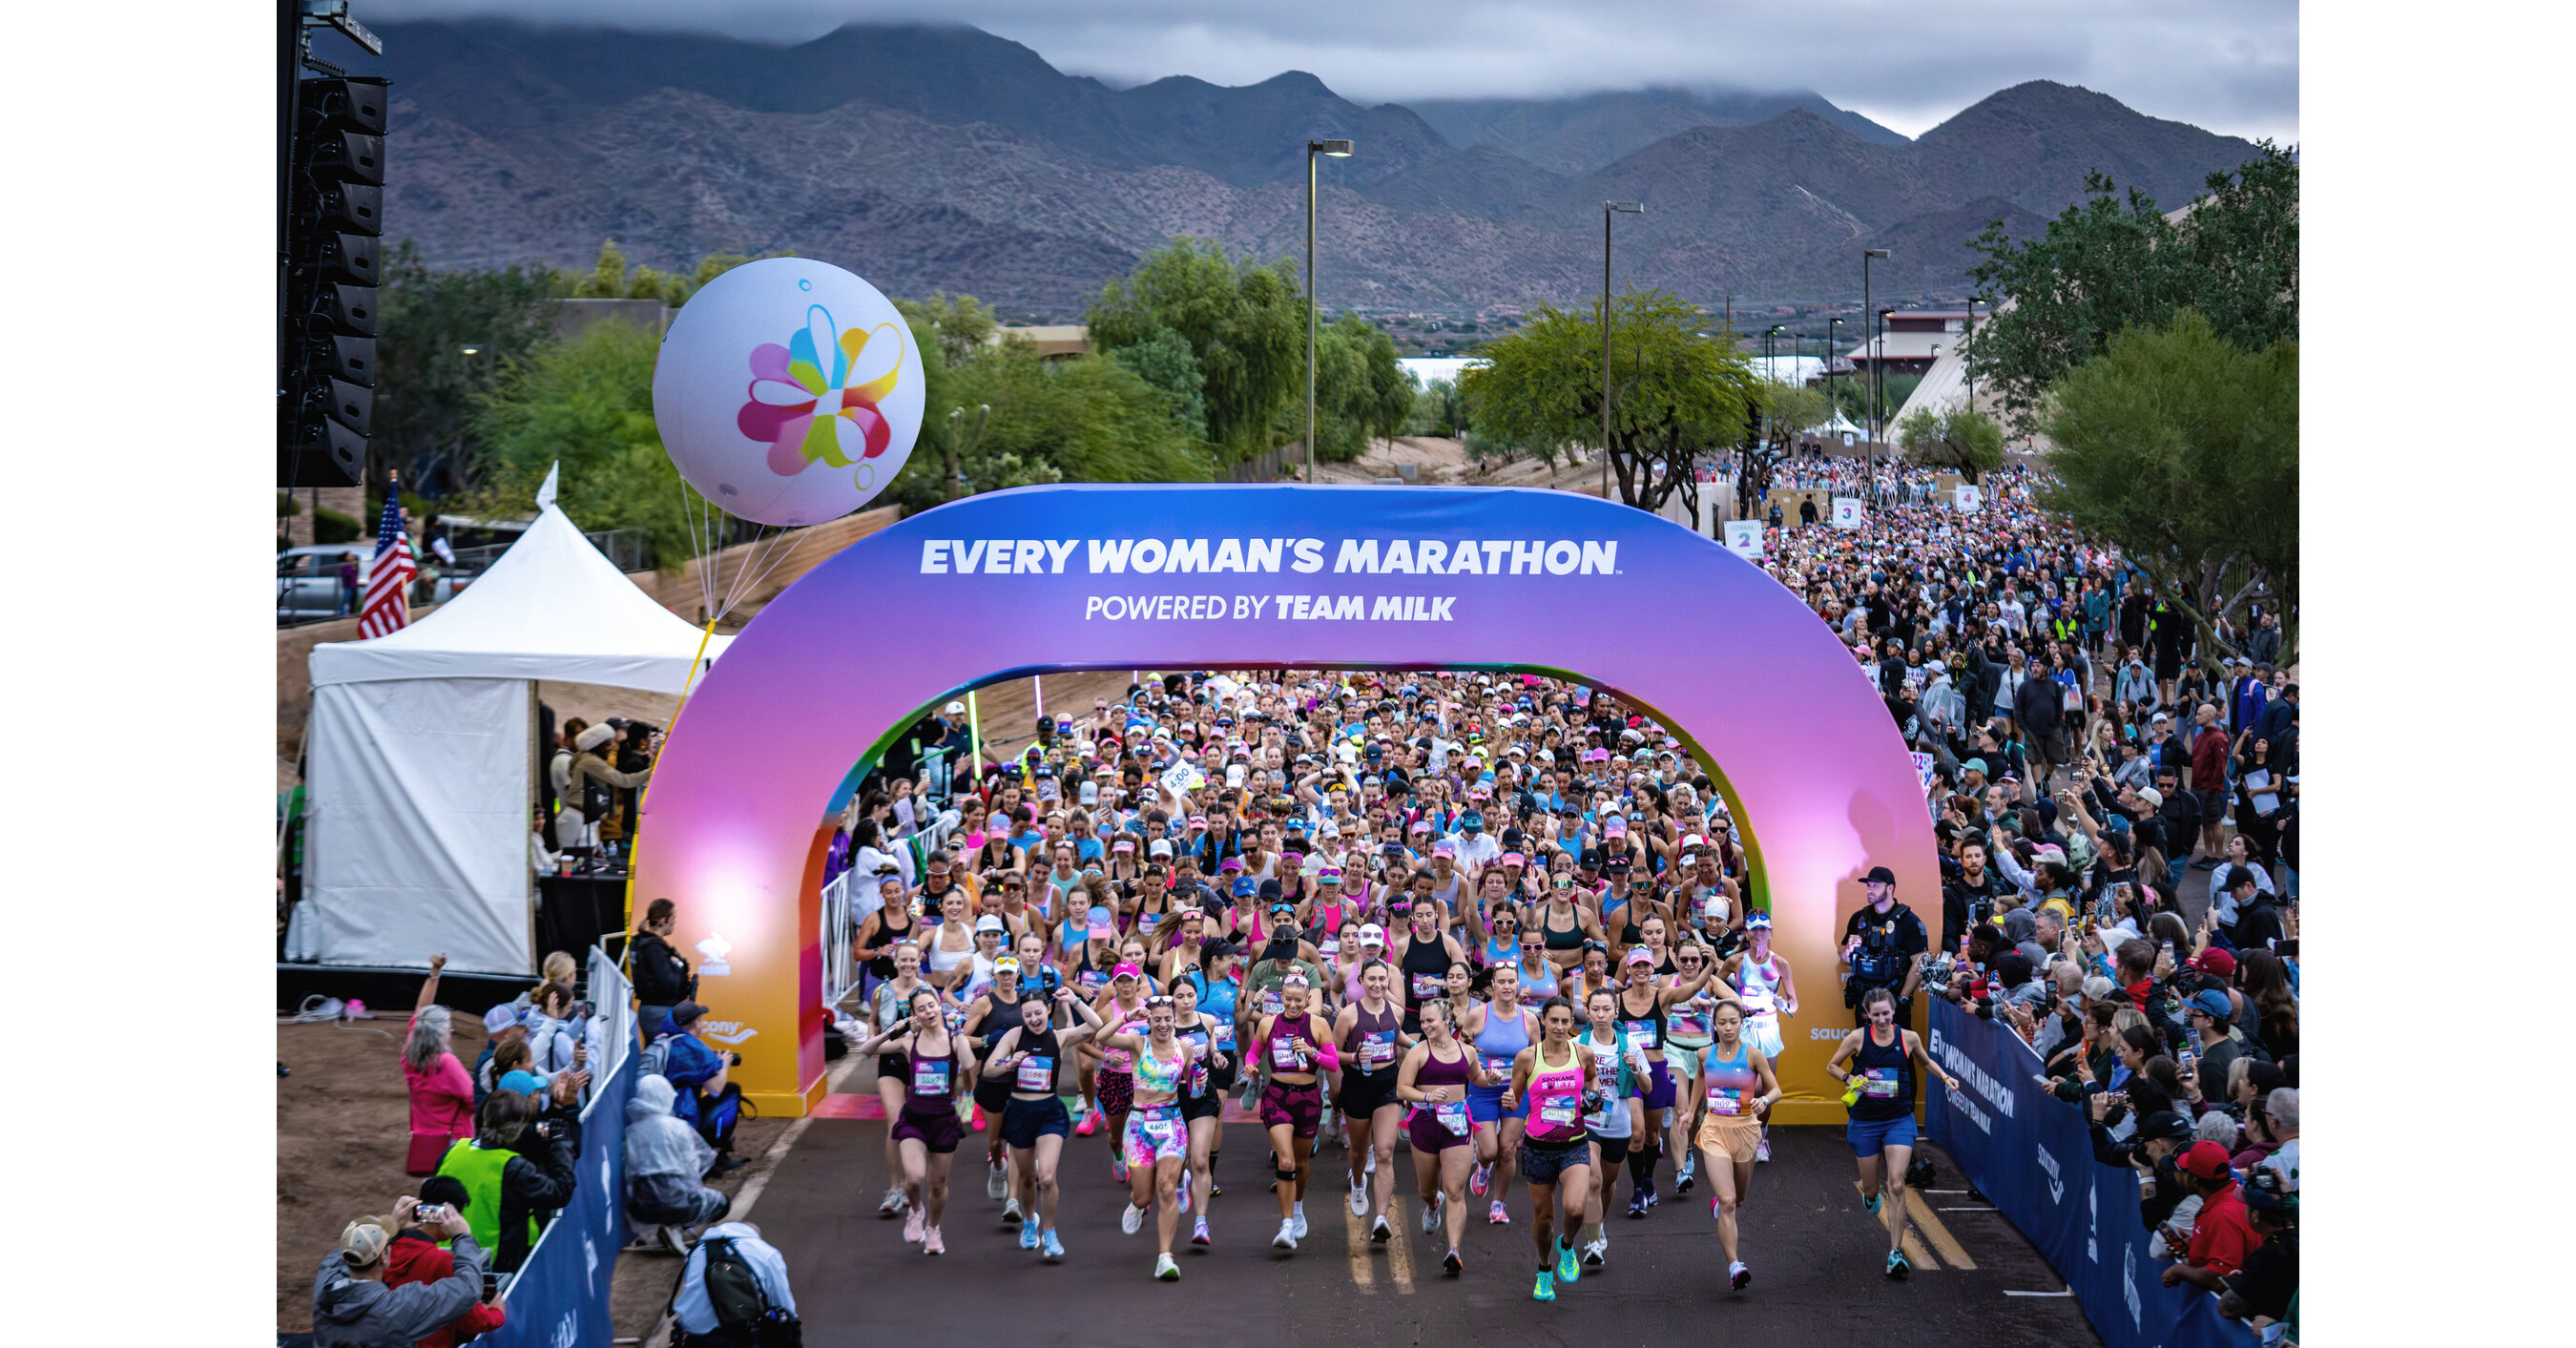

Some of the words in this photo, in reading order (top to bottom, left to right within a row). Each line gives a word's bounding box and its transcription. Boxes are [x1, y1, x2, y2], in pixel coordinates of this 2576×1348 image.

[1963, 493, 1971, 503] 4
[1841, 508, 1852, 519] 3
[1738, 532, 1751, 548] 2
[921, 539, 1079, 574] EVERY
[1087, 538, 1325, 574] WOMAN'S
[1085, 595, 1227, 621] POWERED
[1233, 595, 1271, 620] BY
[1275, 594, 1365, 621] TEAM
[1370, 595, 1457, 621] MILK
[1170, 767, 1190, 788] 4:00
[1945, 1043, 1976, 1089] WOMAN'S
[1976, 1066, 2014, 1119] MARATHON
[2038, 1142, 2061, 1185] saucony
